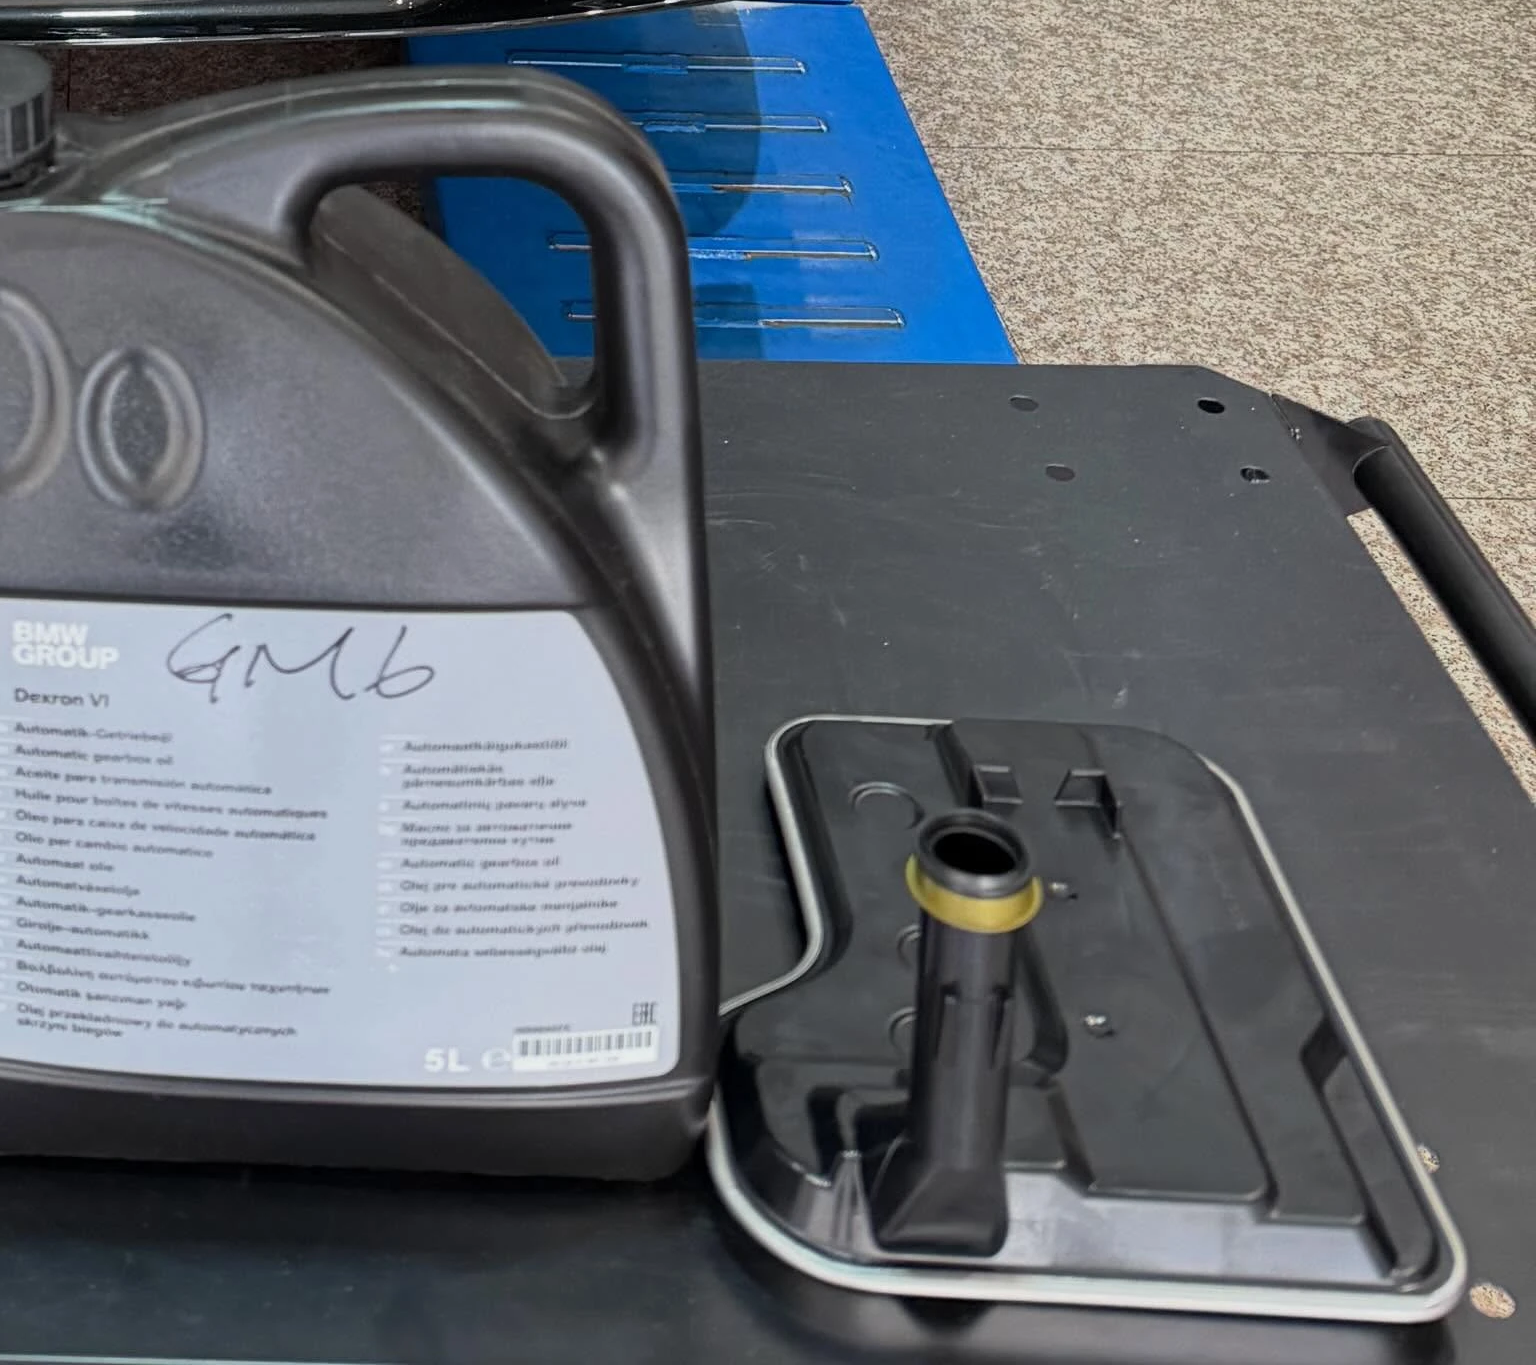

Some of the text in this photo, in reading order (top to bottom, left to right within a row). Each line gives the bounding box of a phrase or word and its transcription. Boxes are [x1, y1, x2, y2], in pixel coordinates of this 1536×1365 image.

[12, 621, 89, 646] BMW
[12, 644, 118, 670] GROUP
[14, 687, 109, 708] Dexron VI
